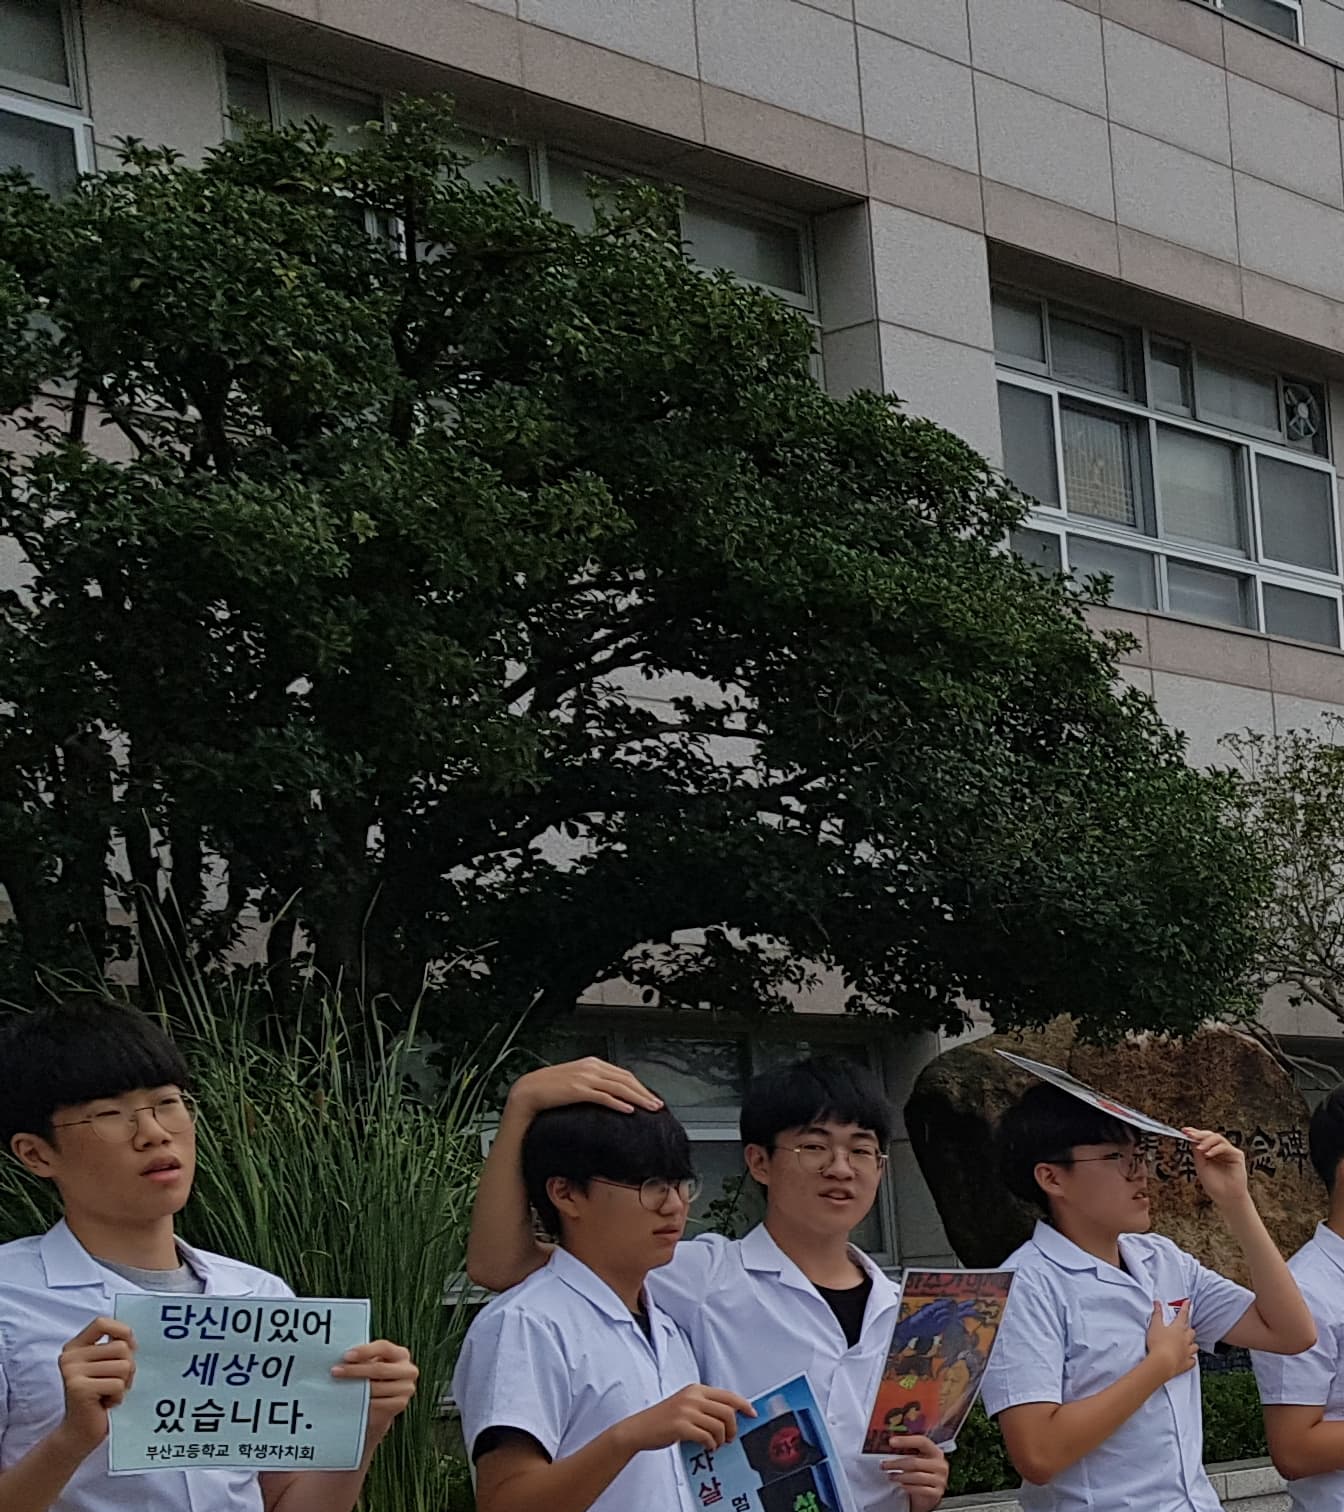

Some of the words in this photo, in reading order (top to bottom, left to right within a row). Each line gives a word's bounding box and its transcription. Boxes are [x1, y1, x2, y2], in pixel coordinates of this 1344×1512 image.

[182, 1353, 295, 1387] 세상이
[154, 1398, 313, 1434] 있습니다.
[146, 1443, 230, 1460] 부산고등학교
[238, 1443, 315, 1461] 학생자치회
